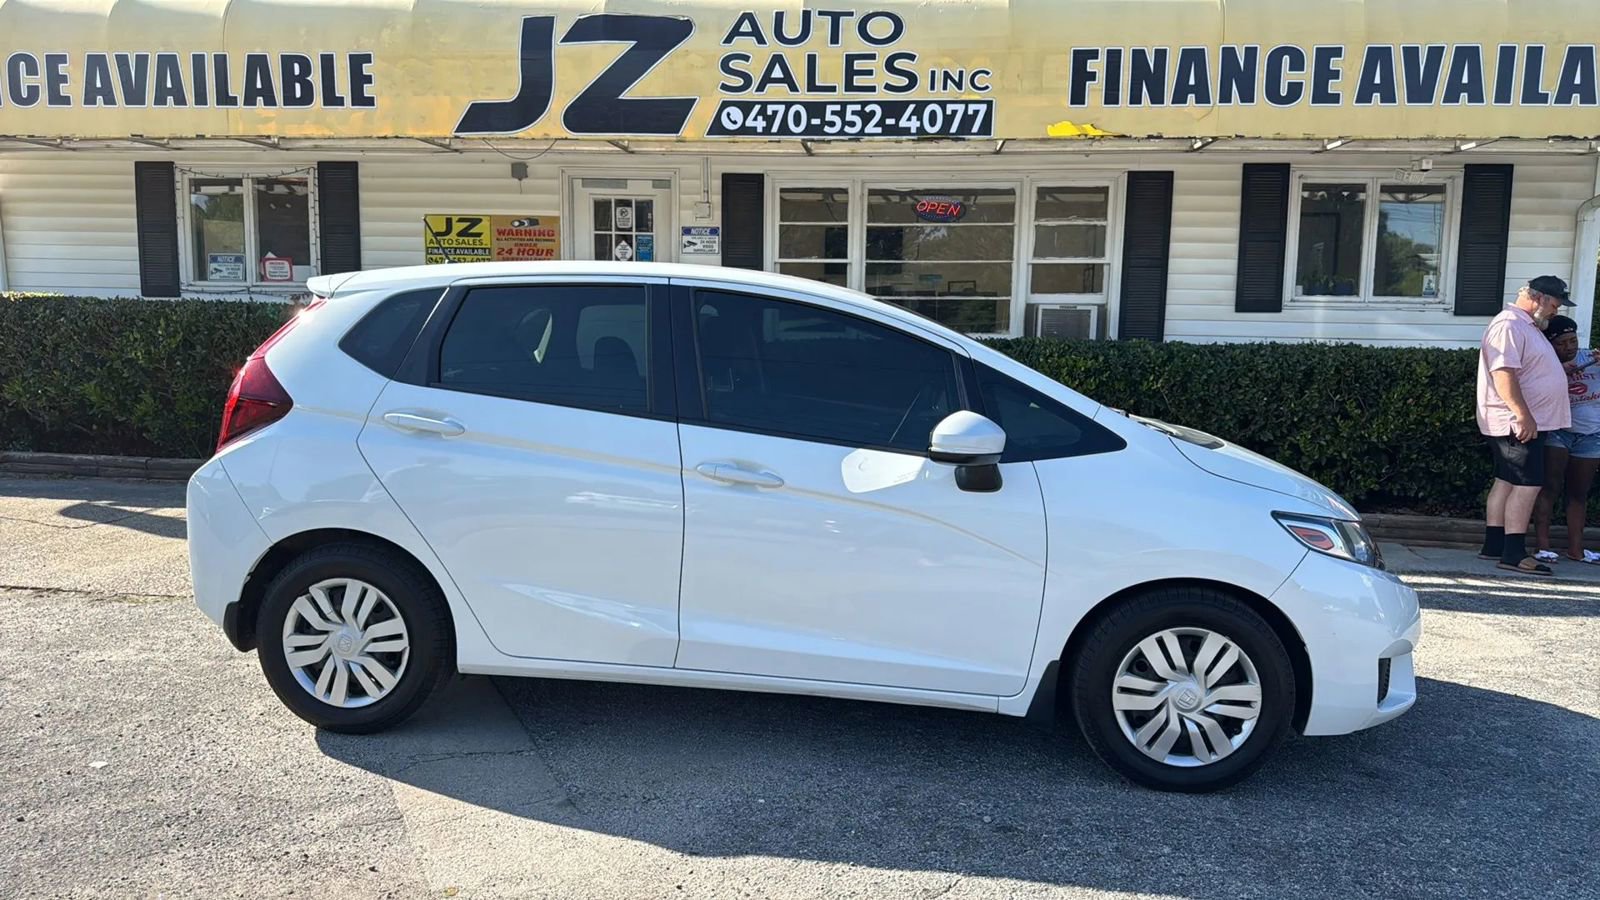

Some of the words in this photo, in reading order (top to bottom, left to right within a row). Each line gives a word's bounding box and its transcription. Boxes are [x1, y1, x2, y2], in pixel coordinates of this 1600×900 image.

[720, 8, 906, 47] AUTO
[0, 51, 73, 107] CE
[82, 52, 376, 108] AVAILABLE
[452, 14, 699, 136] JZ
[718, 51, 920, 95] SALES
[928, 68, 993, 93] INC
[1068, 45, 1345, 107] FINANCE
[745, 103, 988, 134] 470-552-4077
[916, 200, 960, 216] OPEN
[433, 217, 484, 238] JZ
[496, 228, 555, 237] WARNING
[496, 248, 513, 256] 24
[516, 248, 554, 257] HOUR
